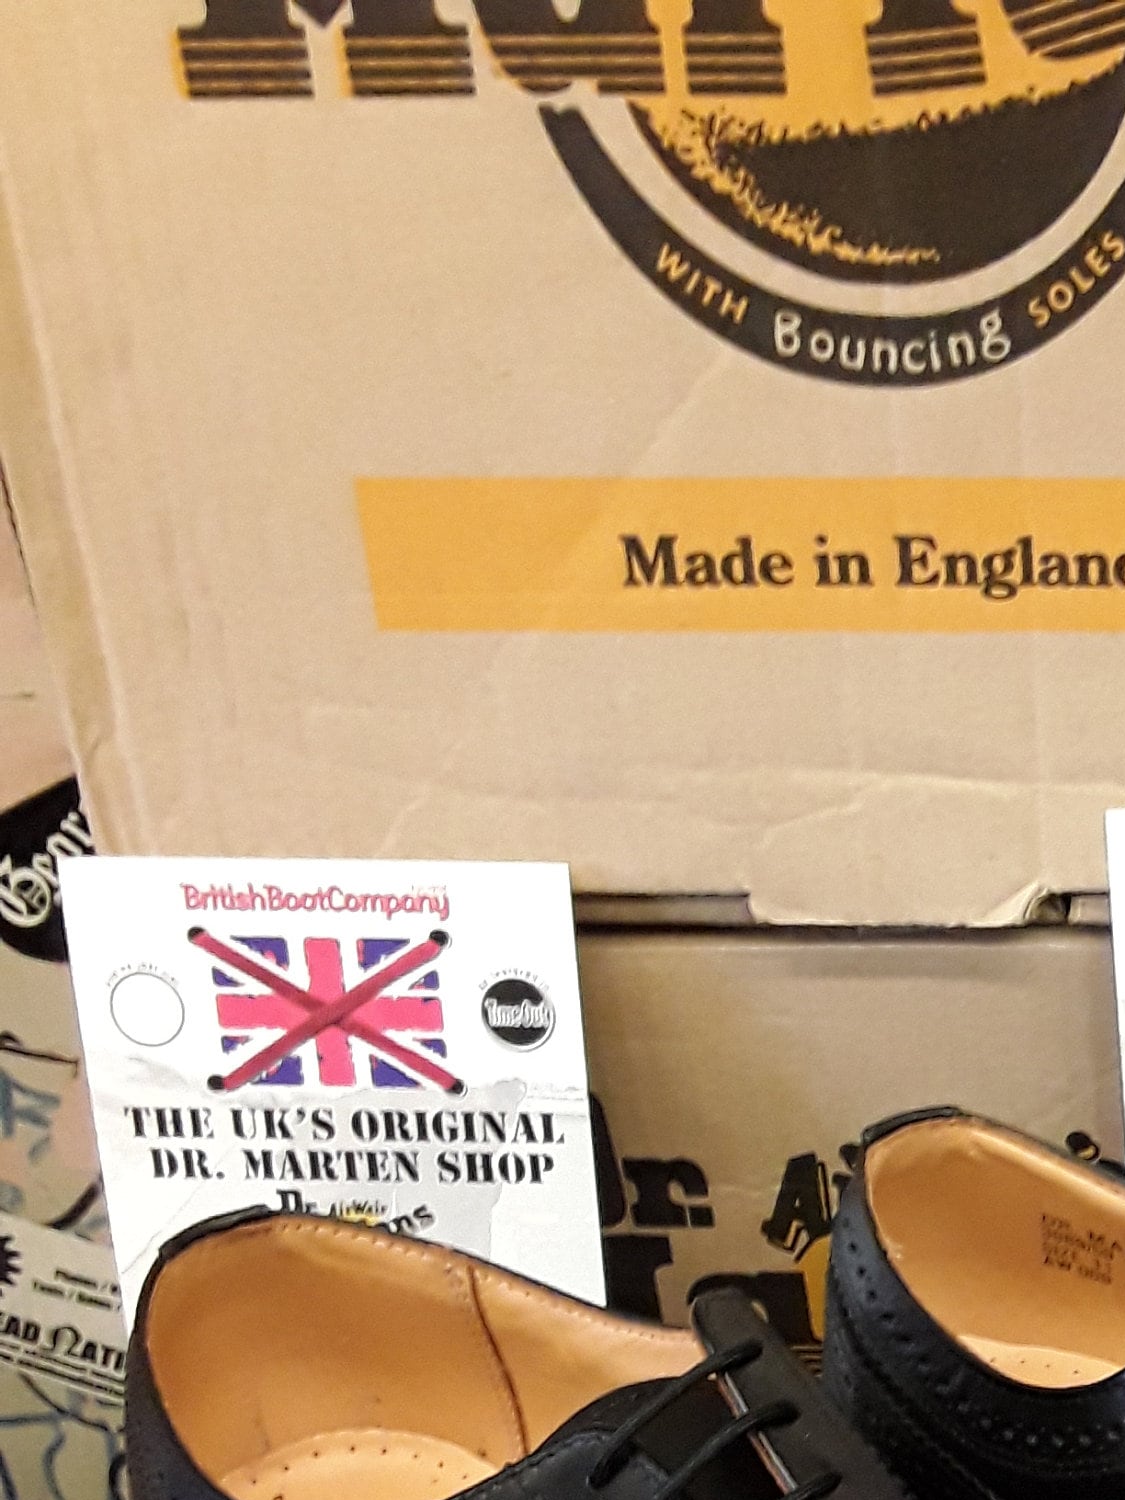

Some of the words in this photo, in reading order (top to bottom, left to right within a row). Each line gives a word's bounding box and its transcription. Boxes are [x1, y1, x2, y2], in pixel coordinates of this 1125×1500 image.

[656, 243, 749, 325] WITH
[773, 307, 1011, 375] Bouncing
[620, 534, 793, 589] Made
[815, 534, 872, 589] in
[123, 1106, 215, 1140] THE
[230, 1106, 336, 1142] UK'S
[351, 1107, 565, 1145] ORIGINAL
[149, 1148, 226, 1180] DR.
[243, 1148, 422, 1183] MARTEN
[437, 1152, 556, 1186] SHOP
